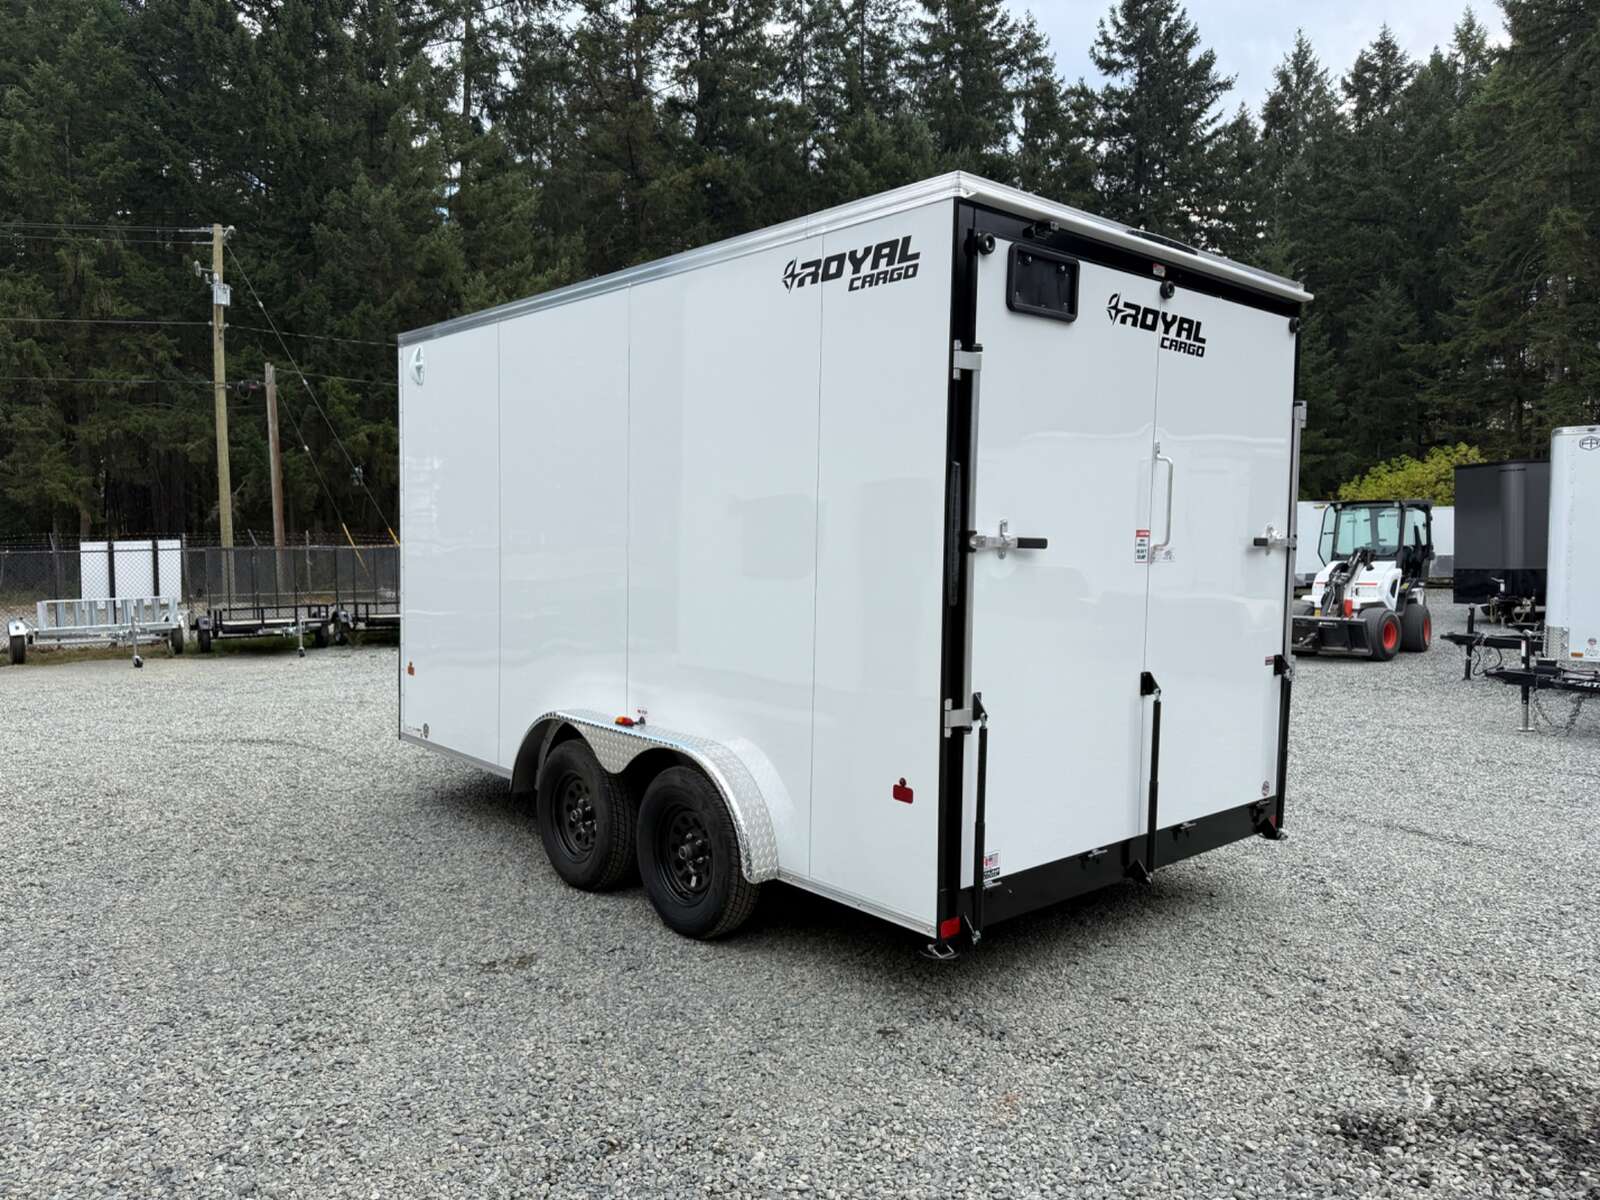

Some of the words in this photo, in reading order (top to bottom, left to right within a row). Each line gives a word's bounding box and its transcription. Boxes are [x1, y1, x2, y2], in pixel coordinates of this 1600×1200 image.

[797, 235, 920, 289] ROYAL
[848, 263, 920, 292] CARGO
[1120, 301, 1206, 345] ROYAL
[1160, 336, 1206, 358] CARGO
